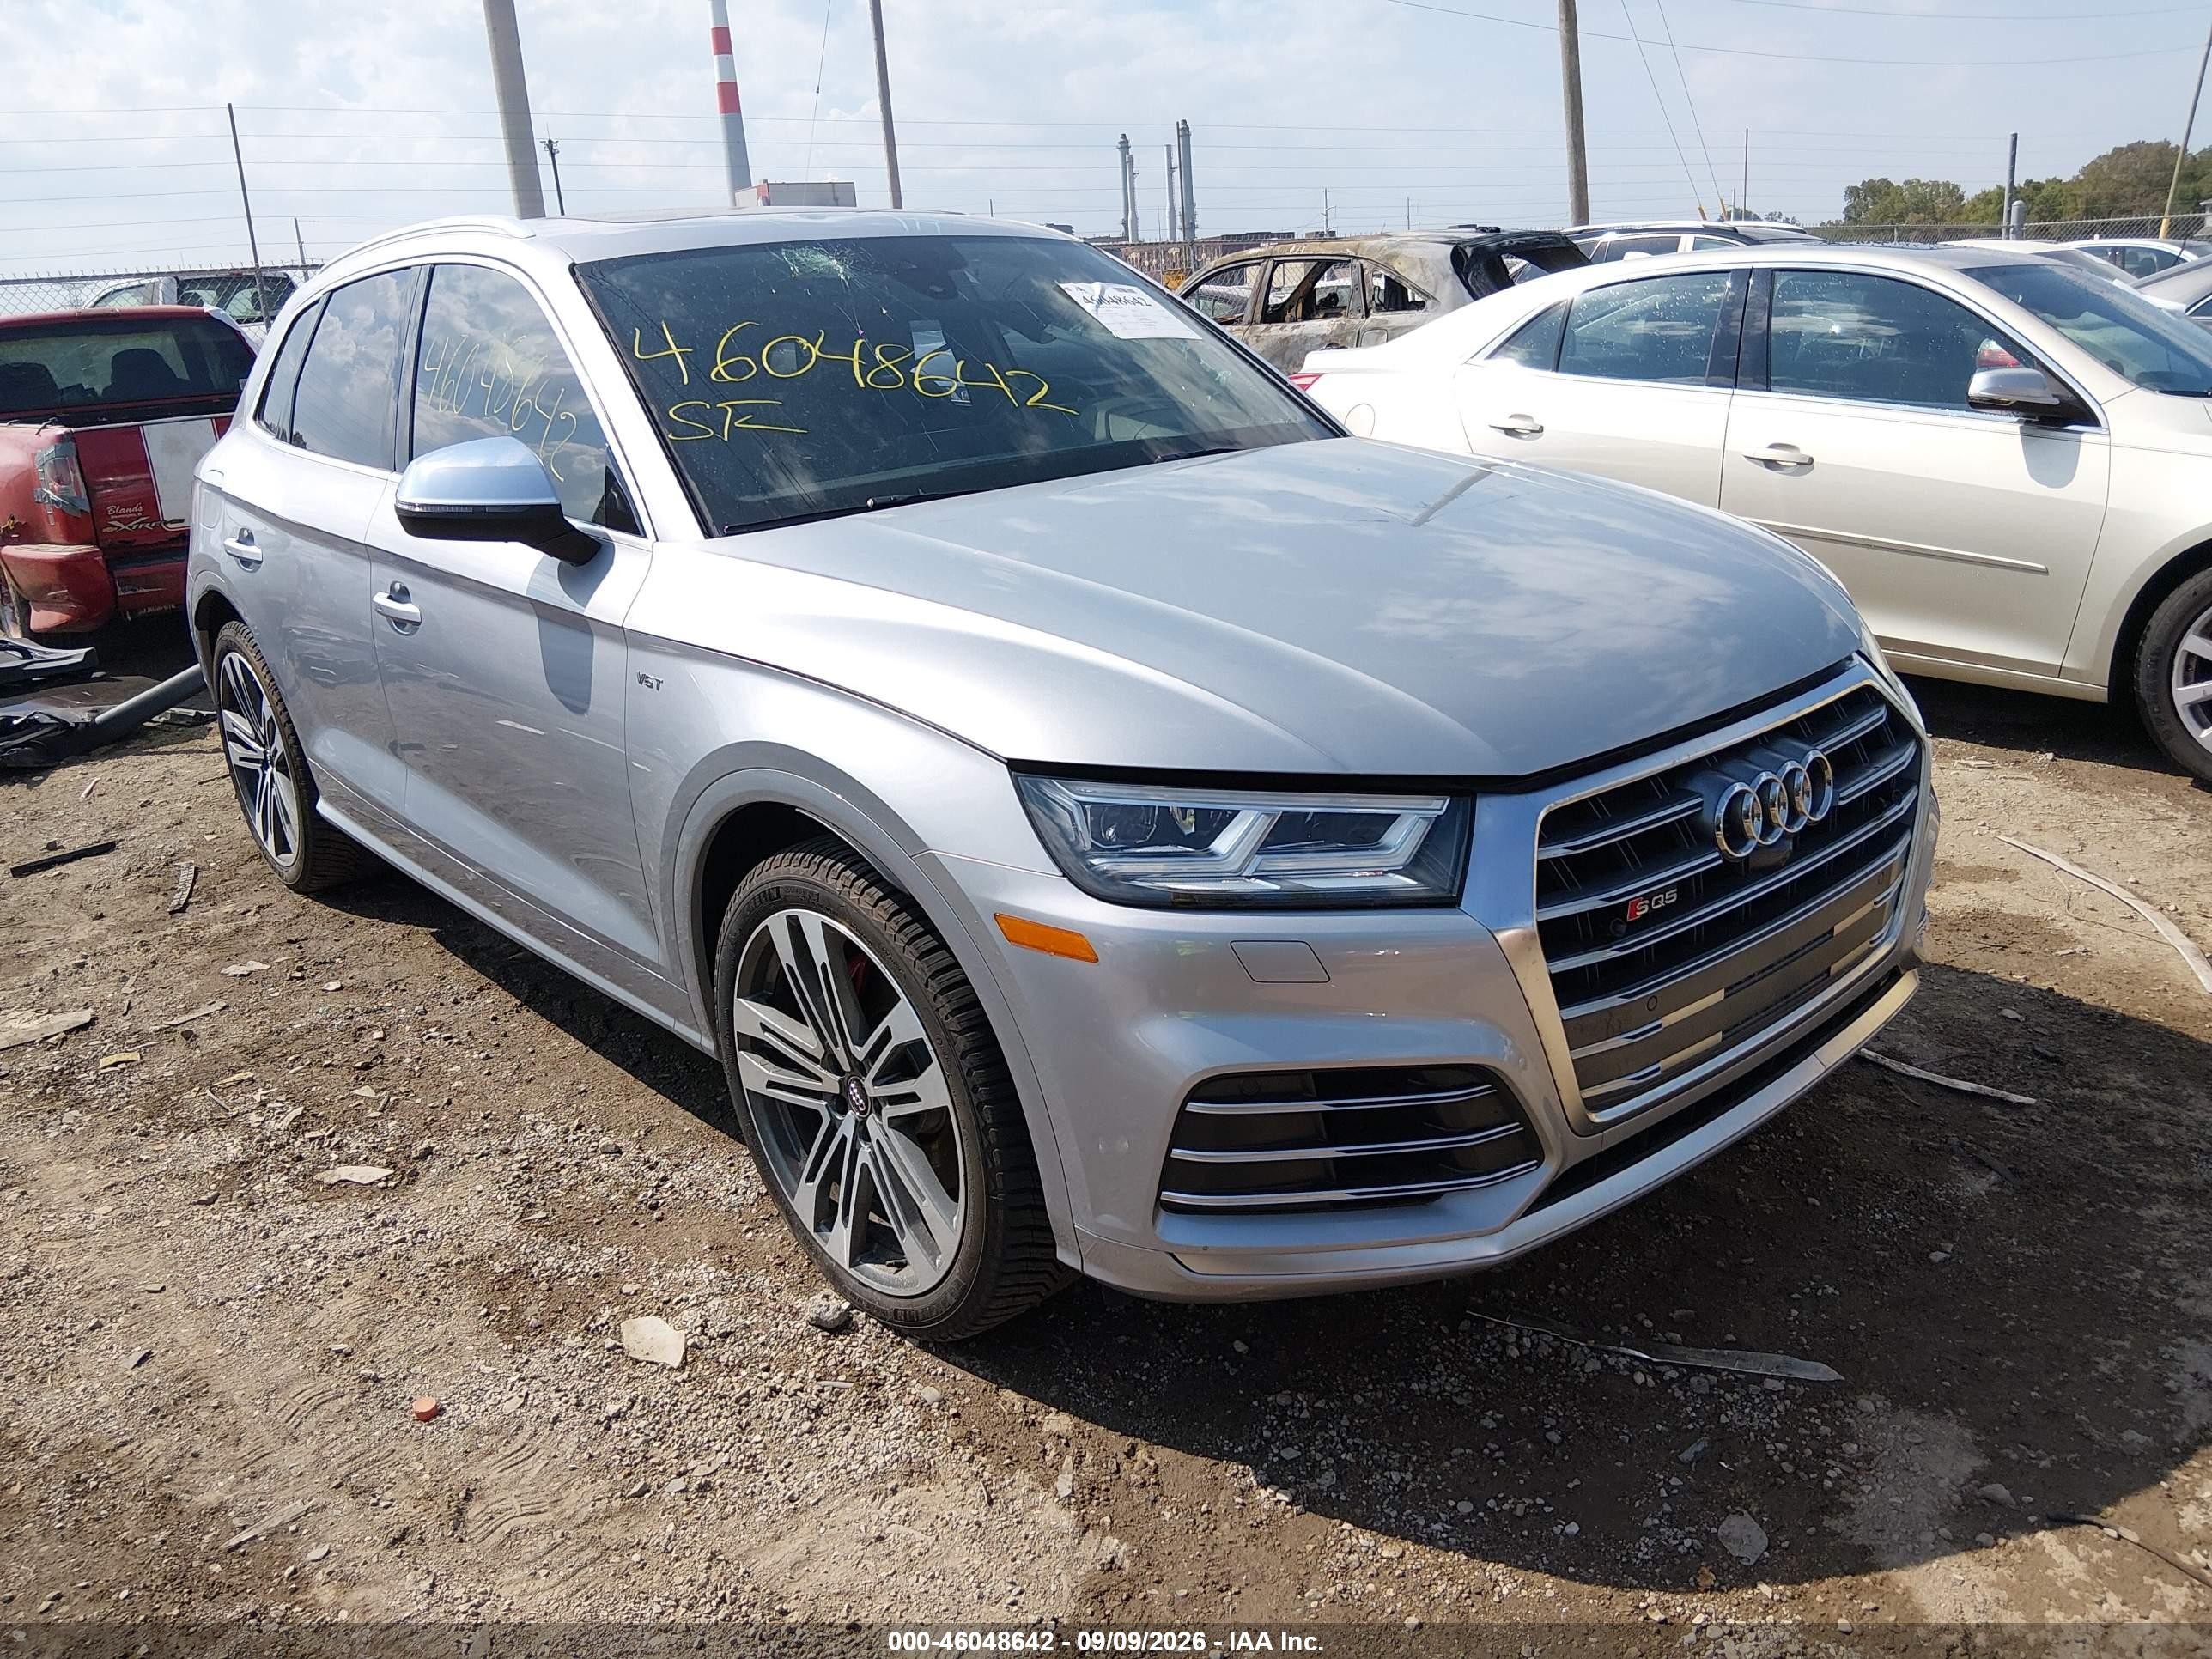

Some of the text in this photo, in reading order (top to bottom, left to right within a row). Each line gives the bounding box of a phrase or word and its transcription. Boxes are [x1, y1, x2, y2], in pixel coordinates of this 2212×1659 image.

[635, 319, 1079, 416] 46048642
[106, 501, 144, 515] Bland's
[1633, 888, 1678, 916] SQ5
